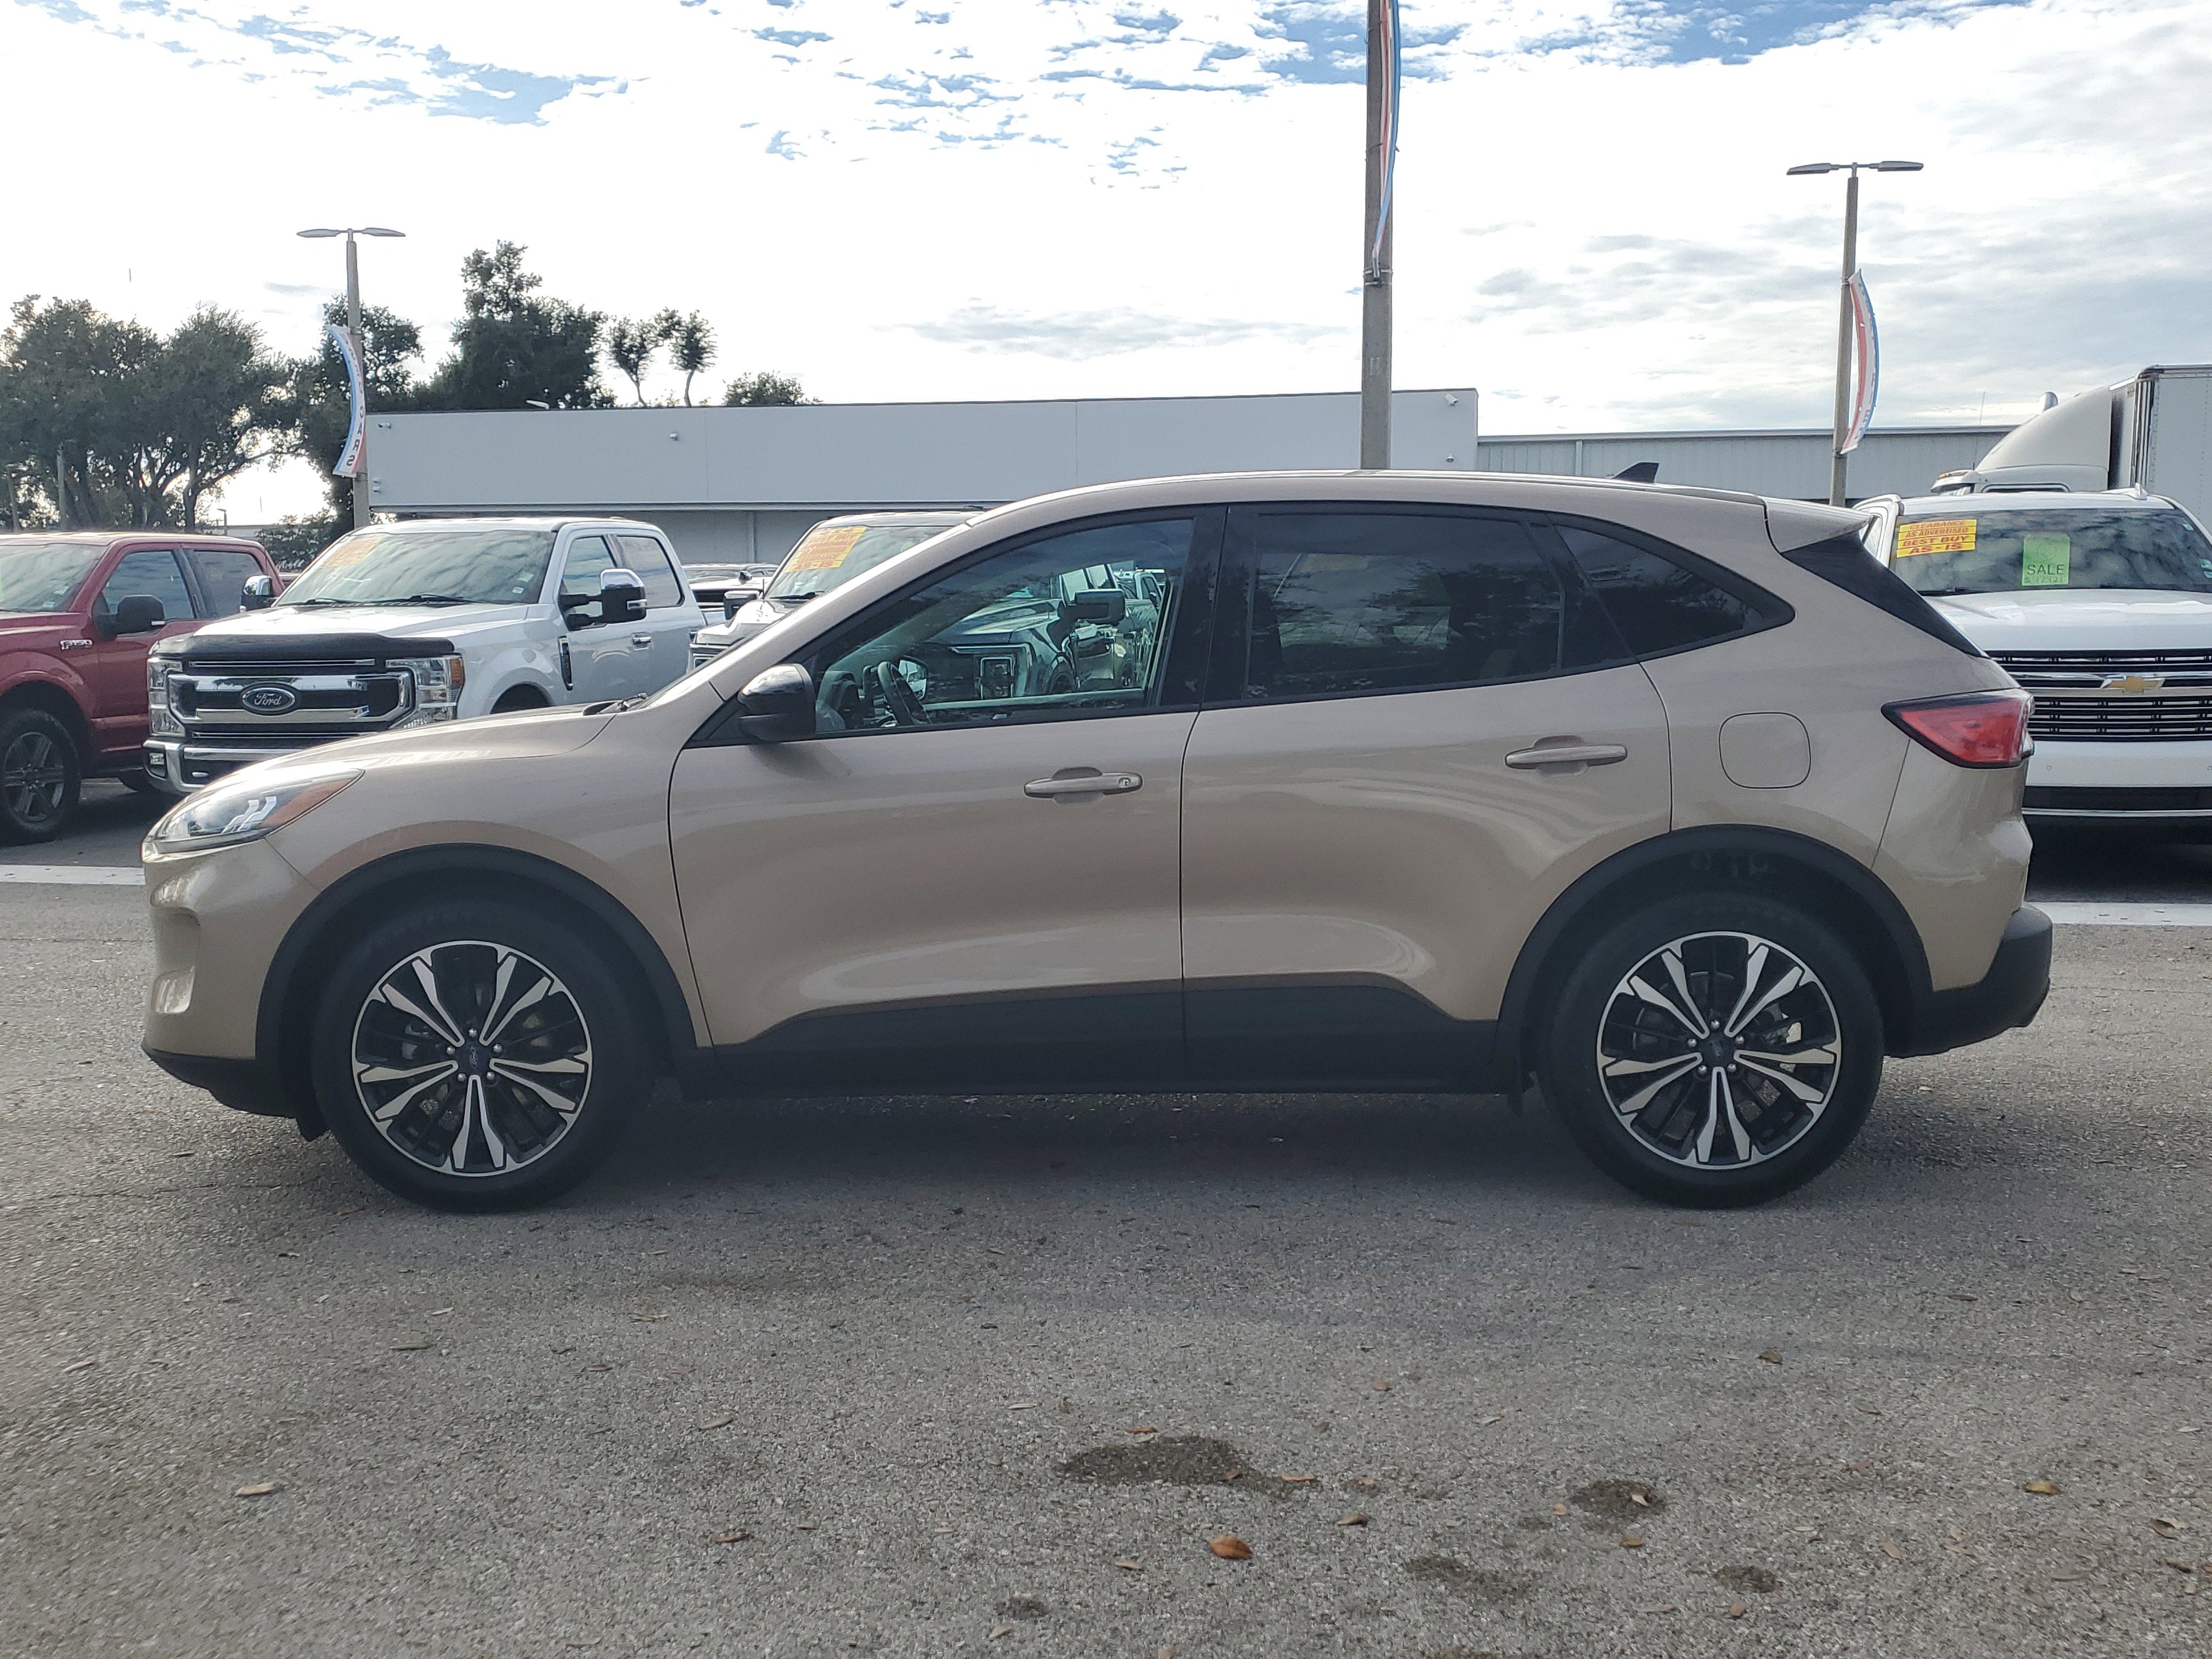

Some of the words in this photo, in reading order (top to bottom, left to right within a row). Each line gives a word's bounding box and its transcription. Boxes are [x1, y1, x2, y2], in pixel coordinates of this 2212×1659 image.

[1910, 520, 1965, 530] CLEARANCE
[1920, 527, 1969, 536] ADVERTISED
[1903, 538, 1936, 546] BEST
[2027, 564, 2064, 575] SALE
[254, 693, 282, 706] Ford
